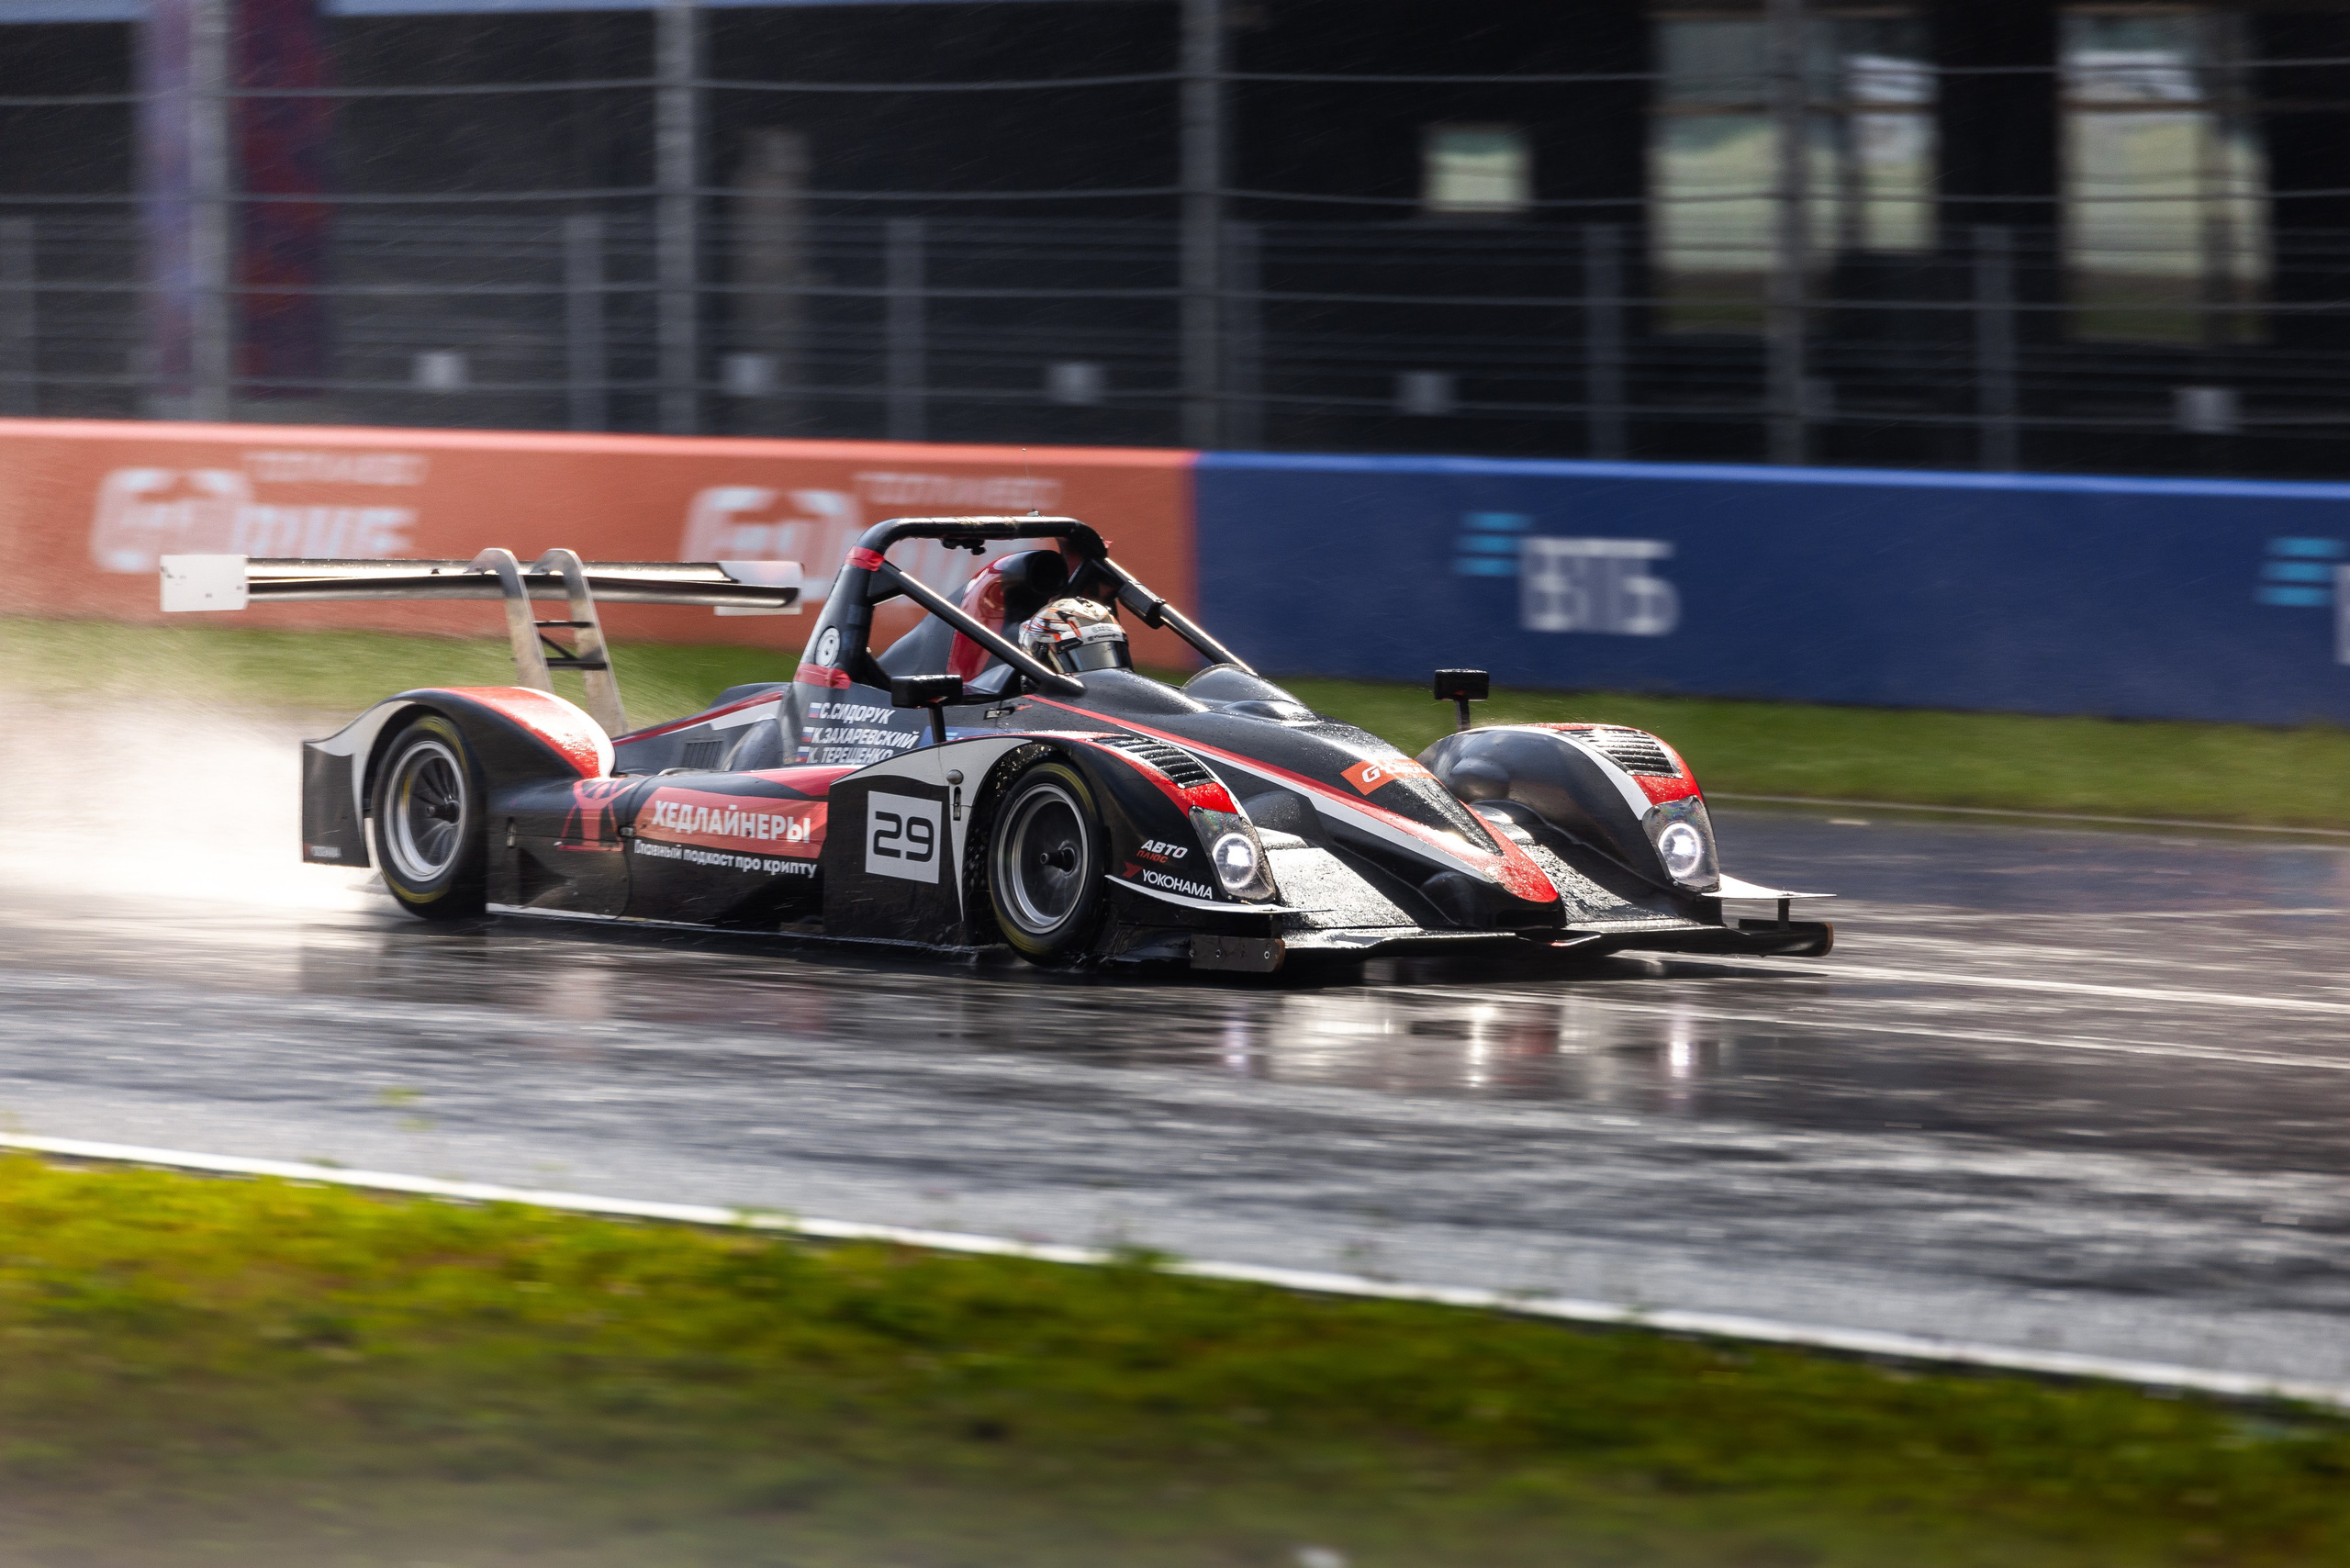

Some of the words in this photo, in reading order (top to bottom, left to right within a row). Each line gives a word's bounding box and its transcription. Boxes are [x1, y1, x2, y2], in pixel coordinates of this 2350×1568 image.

[811, 727, 920, 749] К.ЗАХАРЕВСКИЙ
[651, 800, 811, 843] ХЕДЛАЙНЕРЫ
[873, 811, 934, 863] 29
[634, 839, 683, 860] Главный
[683, 849, 735, 867] подкаст
[735, 857, 762, 872] про
[763, 859, 817, 879] крипту
[1136, 849, 1169, 863] ПЛЮС
[1141, 839, 1188, 858] АВТО
[1142, 868, 1213, 900] YOKOHAMA
